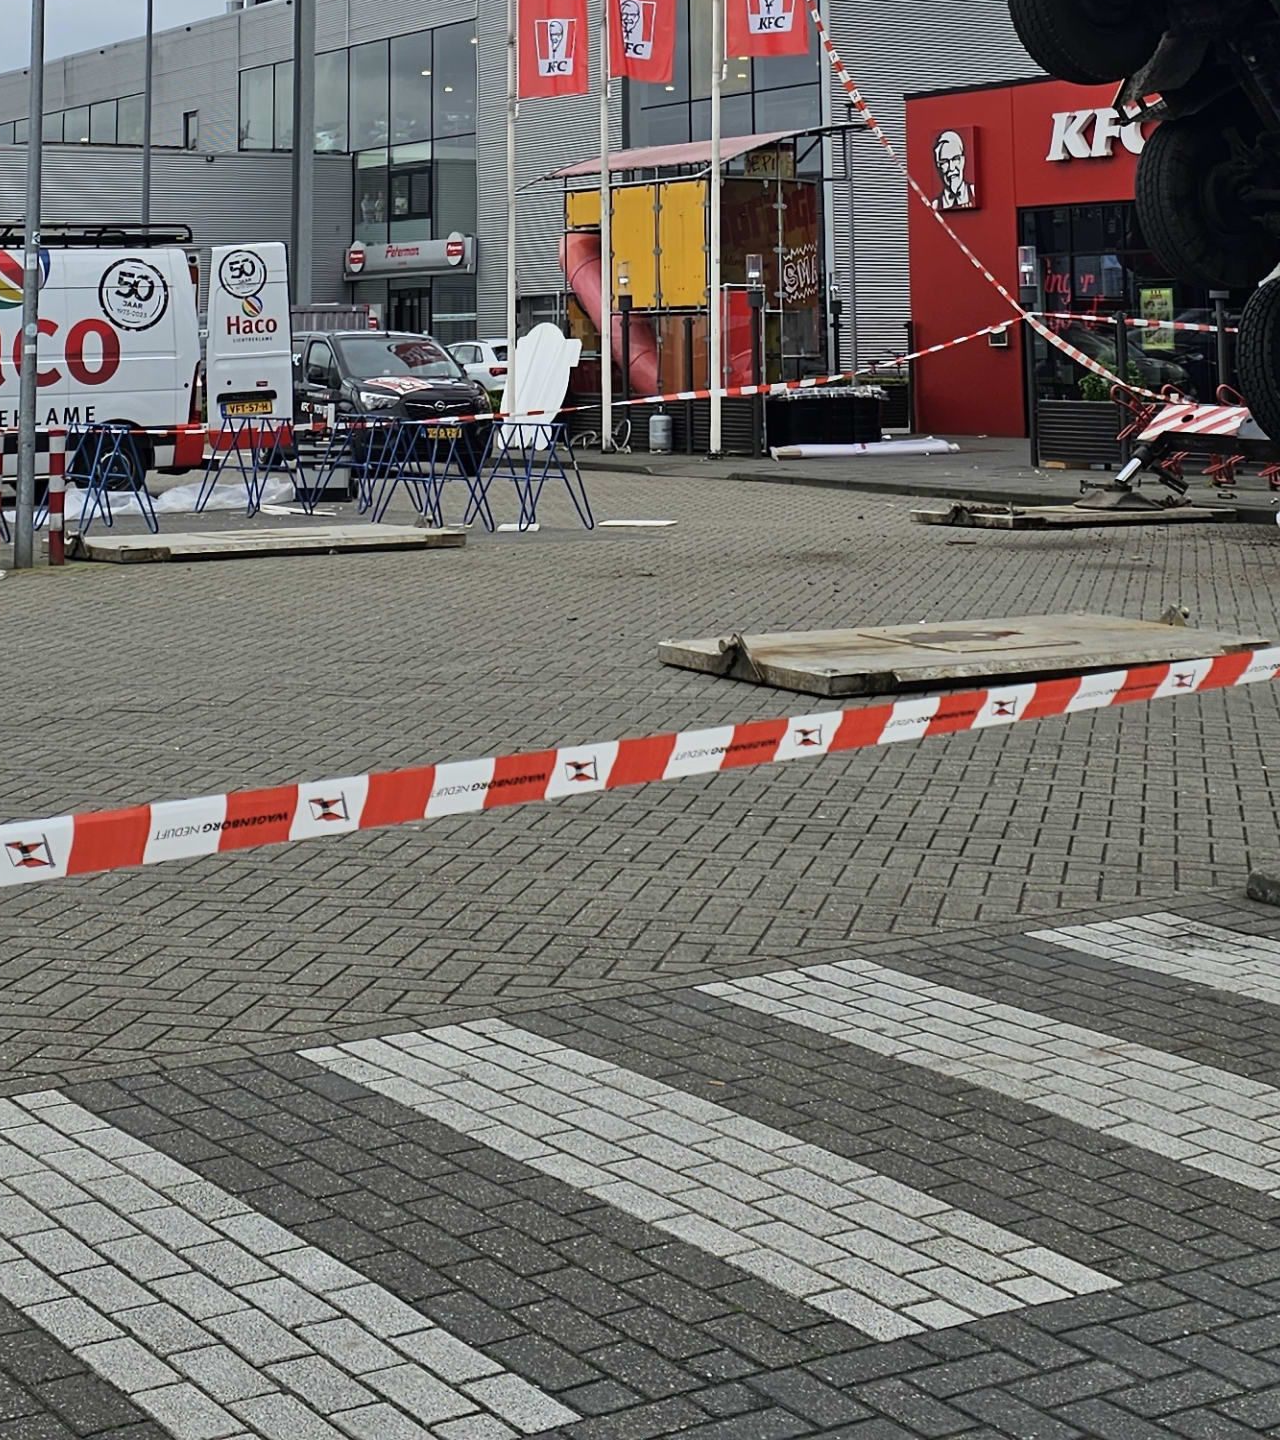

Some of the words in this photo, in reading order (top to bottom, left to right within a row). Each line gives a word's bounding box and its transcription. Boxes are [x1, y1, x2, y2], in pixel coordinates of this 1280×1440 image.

[757, 16, 785, 30] KFC
[625, 42, 644, 56] FC
[546, 61, 567, 73] KFC
[229, 258, 255, 279] 50
[115, 270, 154, 300] 50
[122, 300, 143, 310] JAAR
[226, 316, 277, 335] Haco
[229, 403, 269, 414] VFT-57-H
[203, 812, 288, 833] WAGENBORG
[154, 825, 199, 840] NEDLIFT
